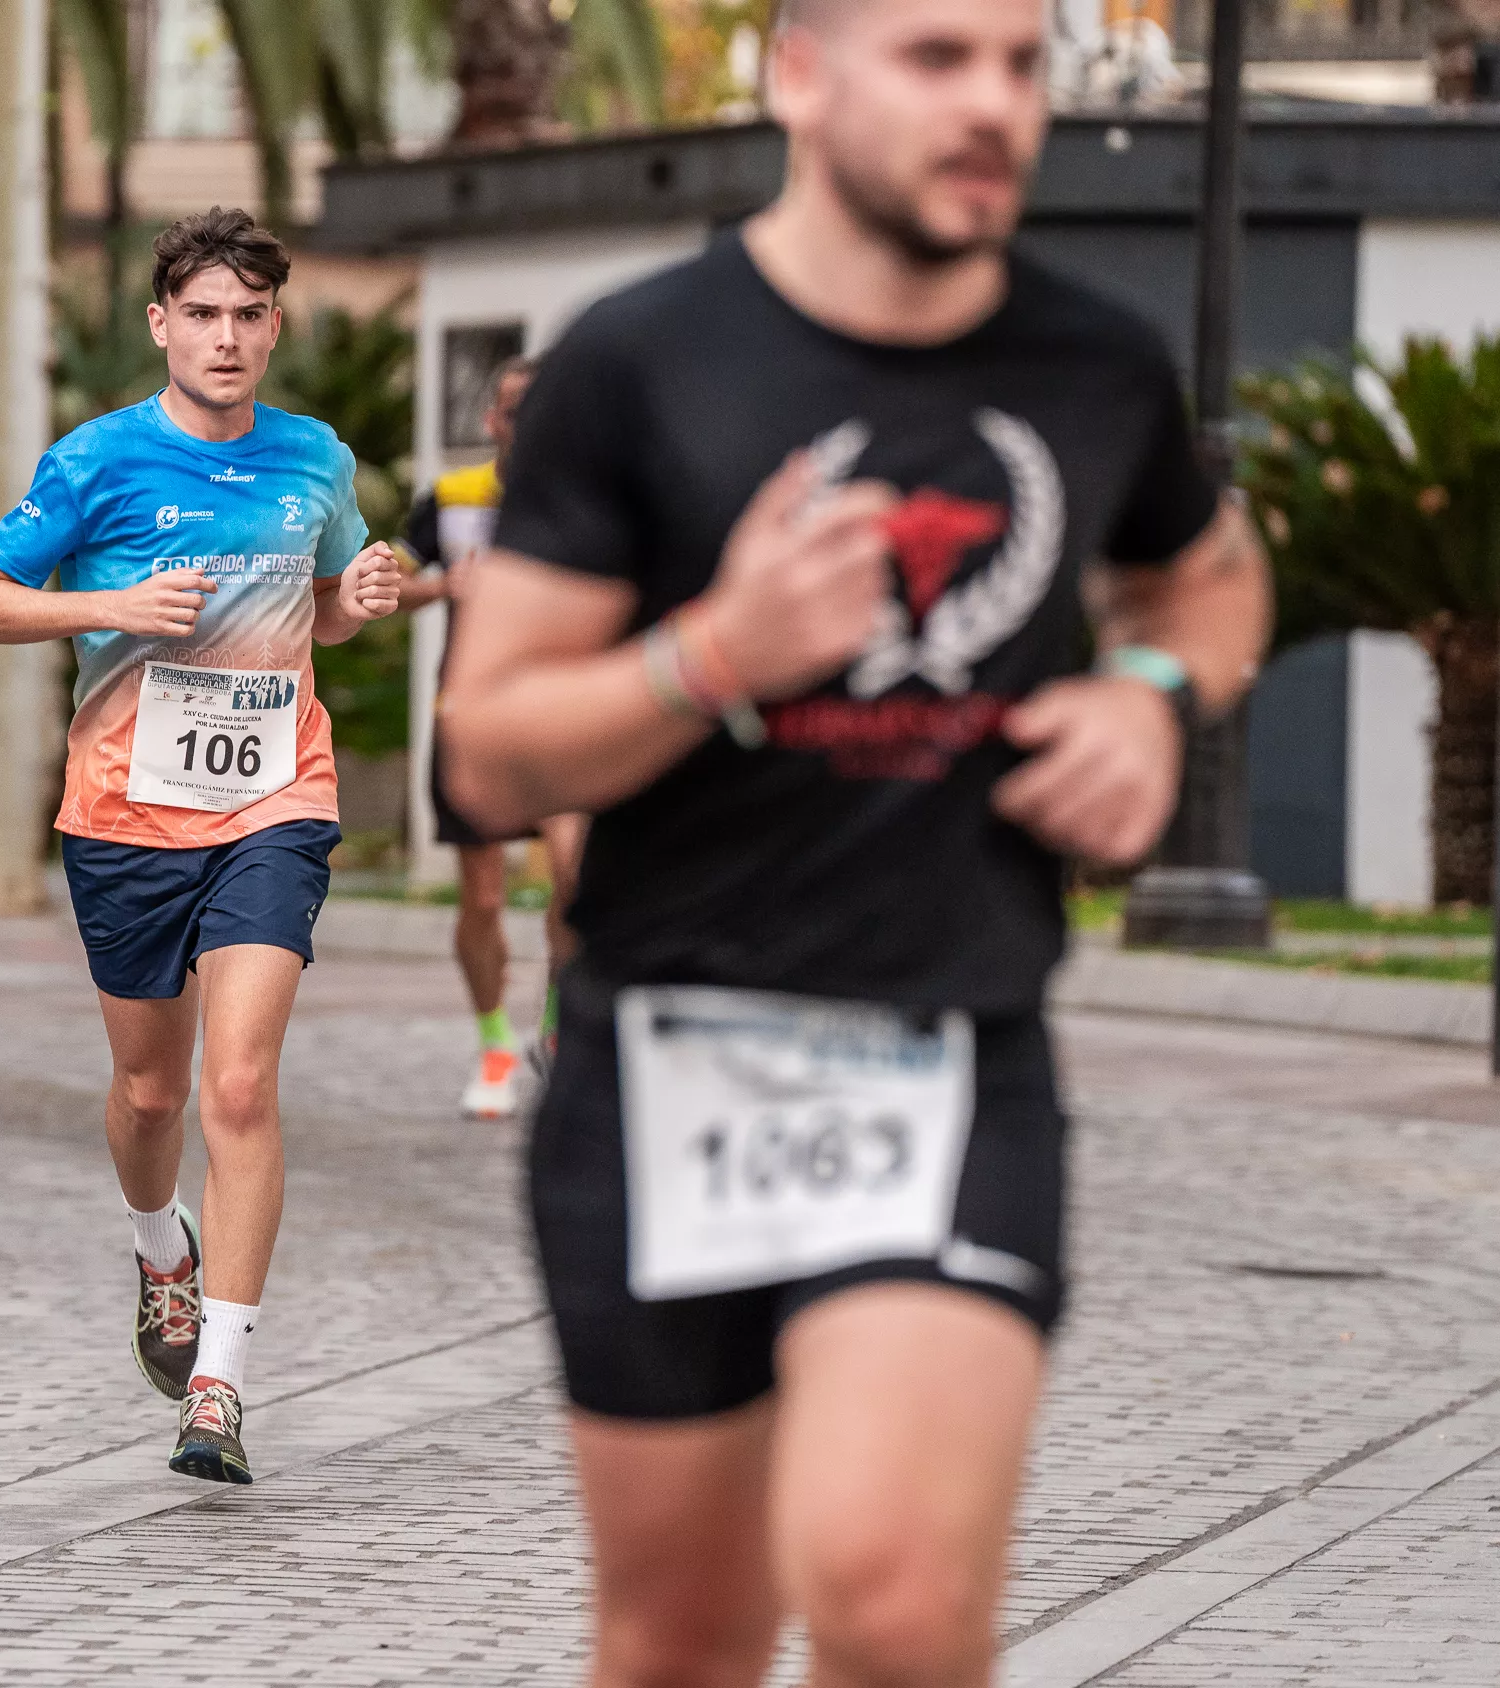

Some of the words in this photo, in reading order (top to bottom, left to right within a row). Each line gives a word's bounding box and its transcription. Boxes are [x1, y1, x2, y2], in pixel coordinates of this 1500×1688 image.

[209, 474, 256, 483] TEAMERGY
[16, 500, 41, 519] OP
[282, 523, 305, 532] running
[192, 554, 246, 572] SUBIDA
[245, 574, 271, 584] VIRGEN
[272, 575, 282, 584] DE
[284, 575, 292, 585] LA
[149, 674, 188, 685] CARRERAS
[189, 679, 232, 691] POPULARES
[151, 666, 181, 678] CIRCUITO
[182, 671, 221, 682] PROVINCIAL
[224, 675, 233, 683] DE
[232, 675, 270, 692] 2024
[183, 709, 197, 717] XXV
[197, 711, 209, 719] C.P.
[209, 713, 233, 722] CIUDAD
[176, 729, 262, 777] 106
[162, 779, 201, 790] FRANCISCO
[202, 784, 225, 794] GÁMIZ
[226, 787, 266, 795] FERNÁNDEZ
